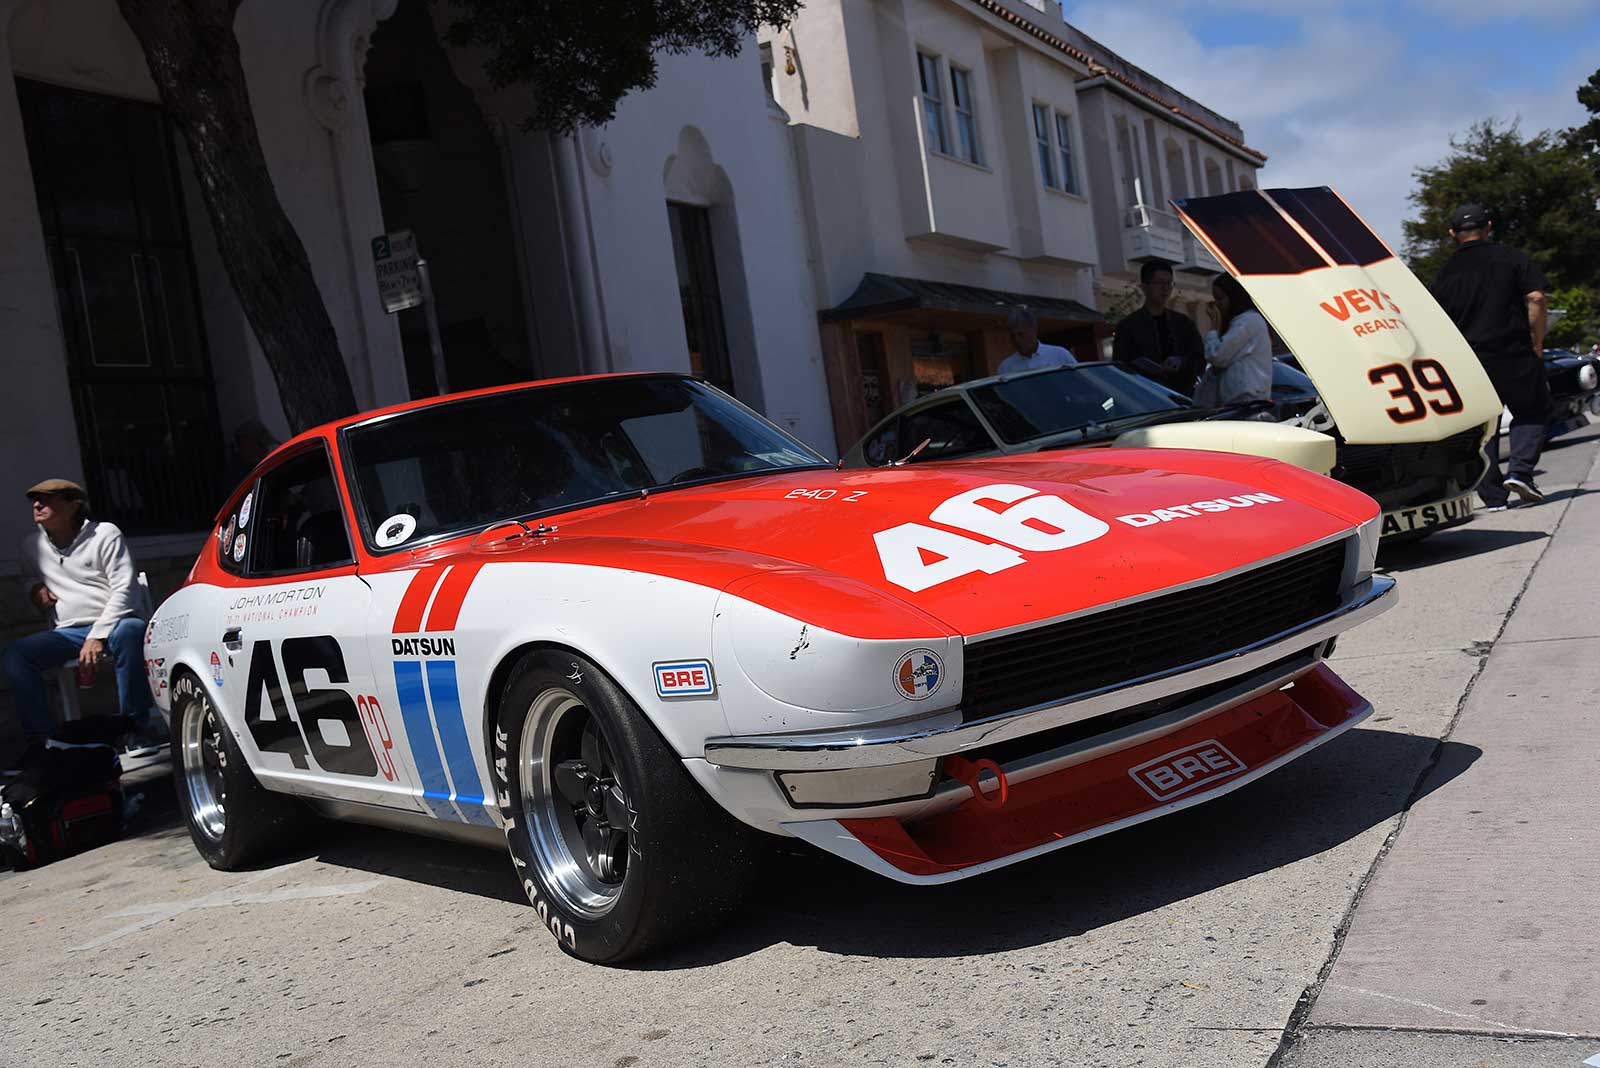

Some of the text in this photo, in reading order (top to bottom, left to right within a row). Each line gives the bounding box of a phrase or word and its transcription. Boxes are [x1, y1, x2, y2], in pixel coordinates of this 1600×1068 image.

[375, 240, 387, 257] 2
[377, 256, 417, 276] PARKING
[1367, 358, 1464, 425] 39
[841, 490, 868, 502] Z
[1115, 492, 1284, 528] DATSUN
[1381, 496, 1470, 535] ATSUN
[872, 484, 1110, 593] 46
[230, 585, 326, 610] JOHN MORTON
[279, 604, 318, 620] CHAMPION
[391, 638, 456, 656] DATSUN
[662, 670, 705, 687] BRE
[245, 635, 378, 777] 46
[1144, 748, 1233, 791] BRE
[495, 724, 577, 950] GOODYEAR
